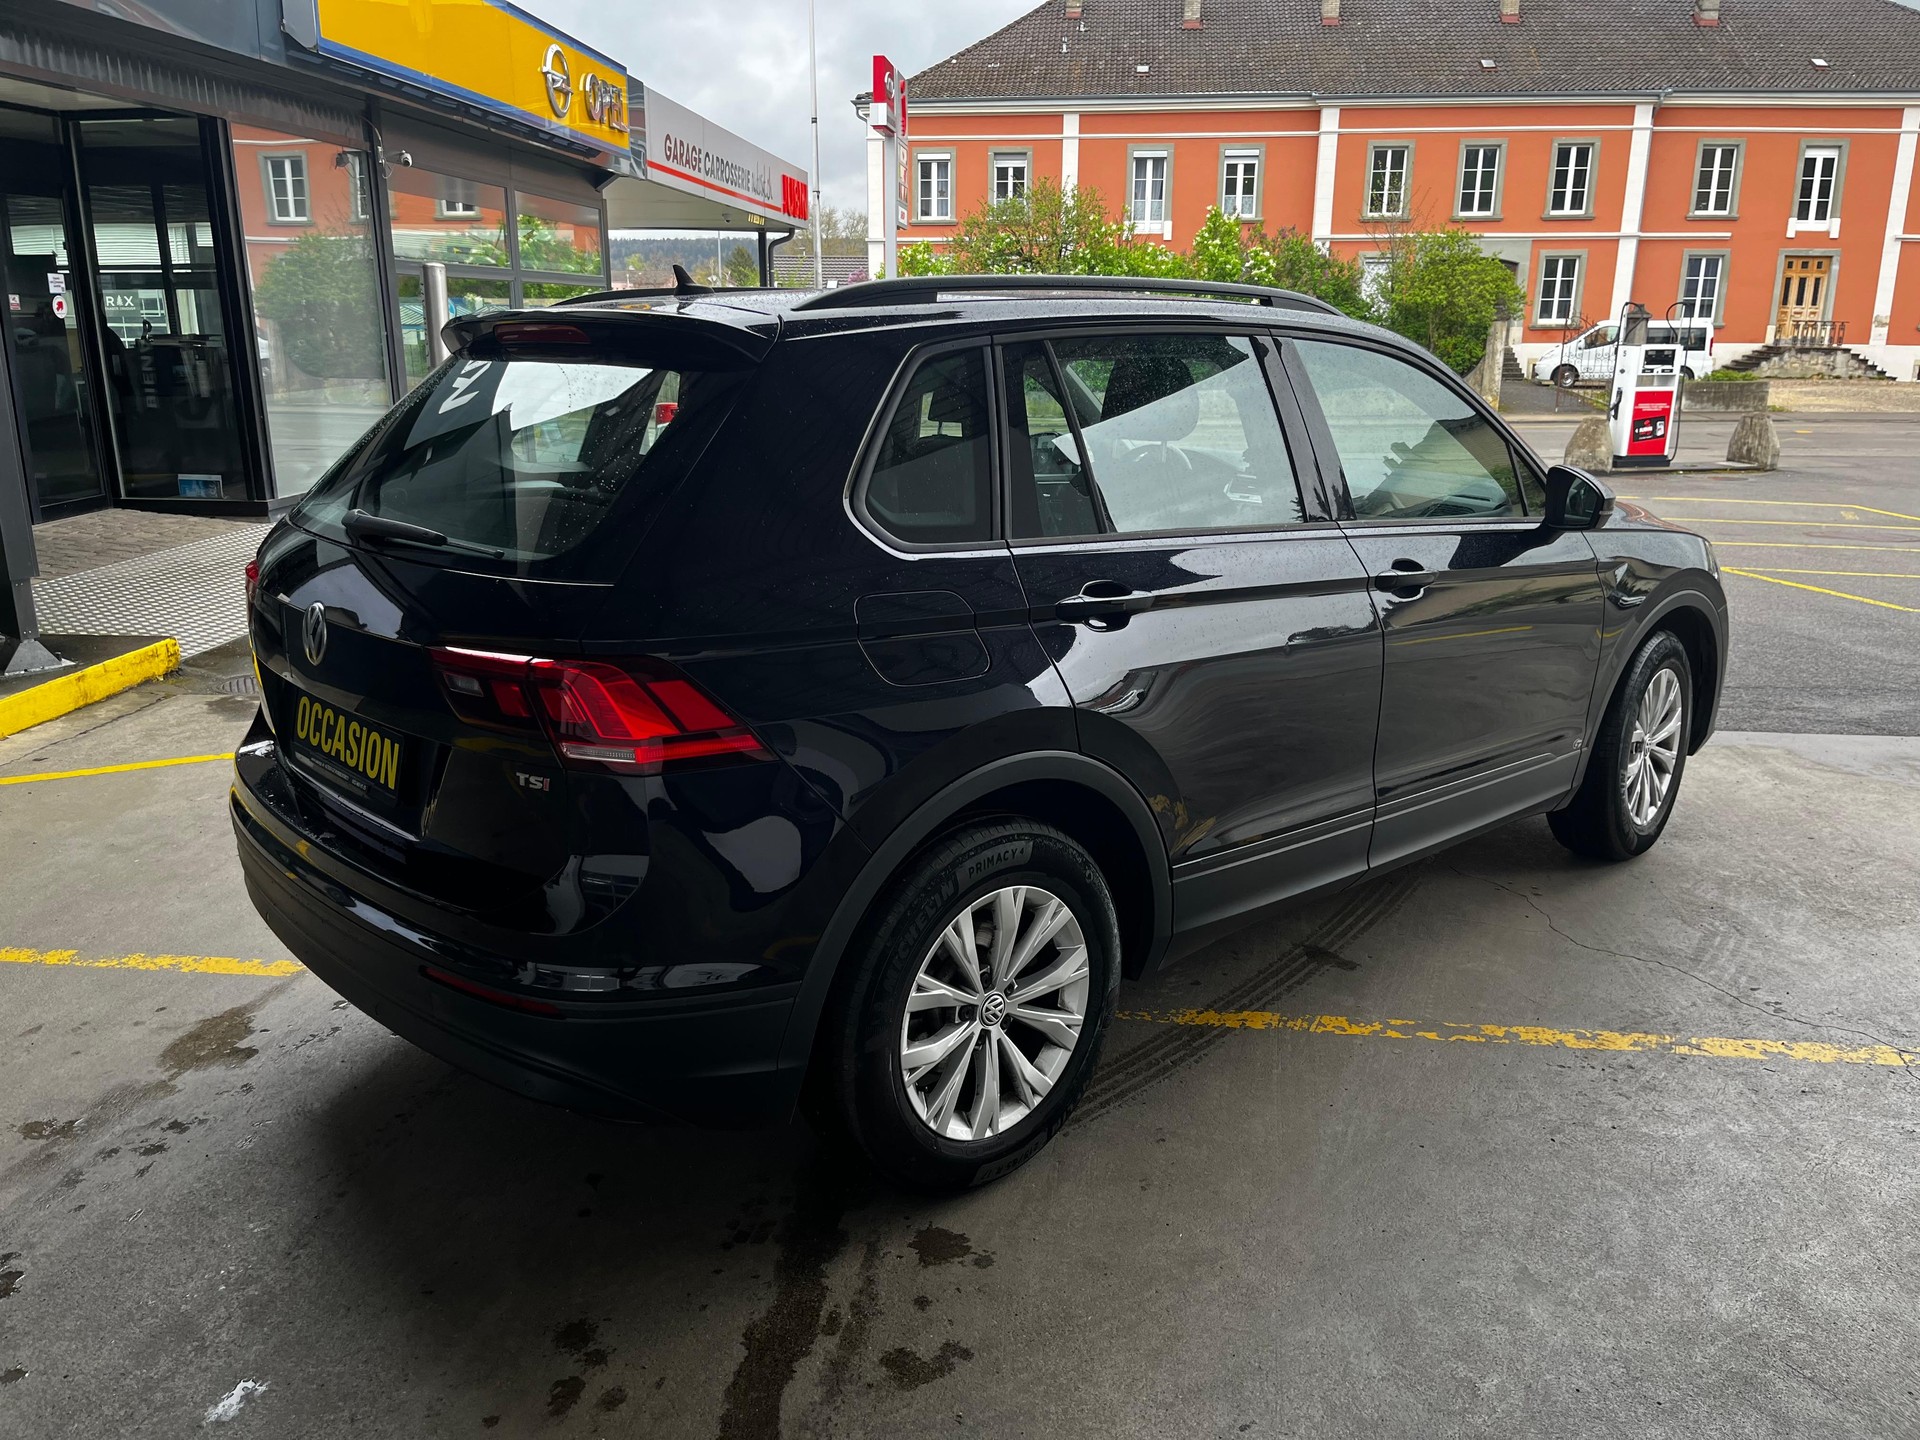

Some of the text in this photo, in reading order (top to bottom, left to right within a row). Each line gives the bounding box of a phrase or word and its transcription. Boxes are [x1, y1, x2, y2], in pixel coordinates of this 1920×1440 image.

[584, 72, 628, 133] OPEL
[664, 133, 702, 174] GARAGE
[703, 151, 751, 192] CARROSSERIE
[296, 695, 400, 790] OCCASION
[515, 772, 550, 792] TSI
[967, 848, 1019, 879] PRIMACY
